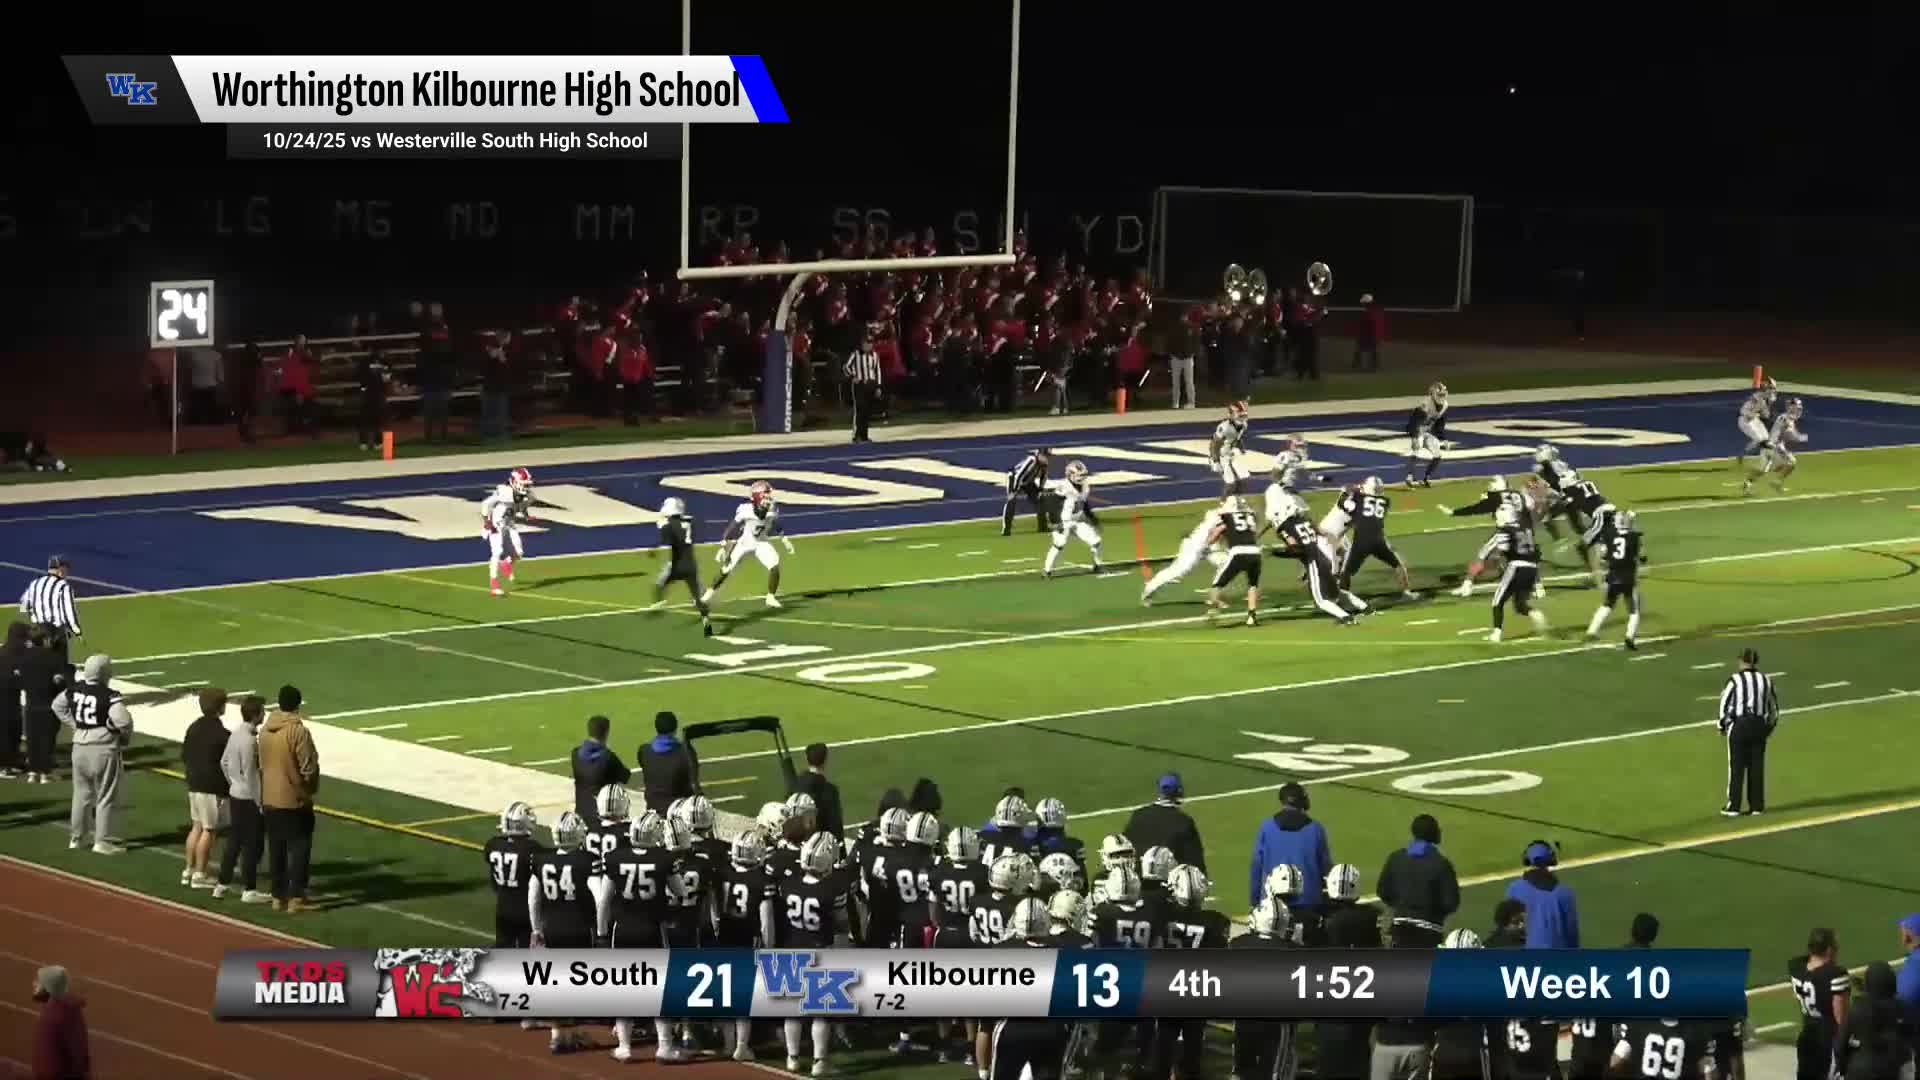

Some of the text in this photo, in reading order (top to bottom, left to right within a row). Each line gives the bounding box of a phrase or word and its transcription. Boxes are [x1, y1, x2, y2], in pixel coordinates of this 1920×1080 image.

[575, 203, 636, 240] MM
[157, 289, 208, 340] 24
[1362, 496, 1387, 519] 56
[1612, 537, 1627, 560] 3
[73, 691, 98, 725] 72
[489, 851, 518, 887] 37
[541, 863, 576, 900] 64
[619, 863, 656, 900] 75
[786, 893, 821, 932] 26
[974, 906, 1004, 944] 39
[1507, 1018, 1532, 1052] 15
[1642, 1033, 1686, 1079] 69
